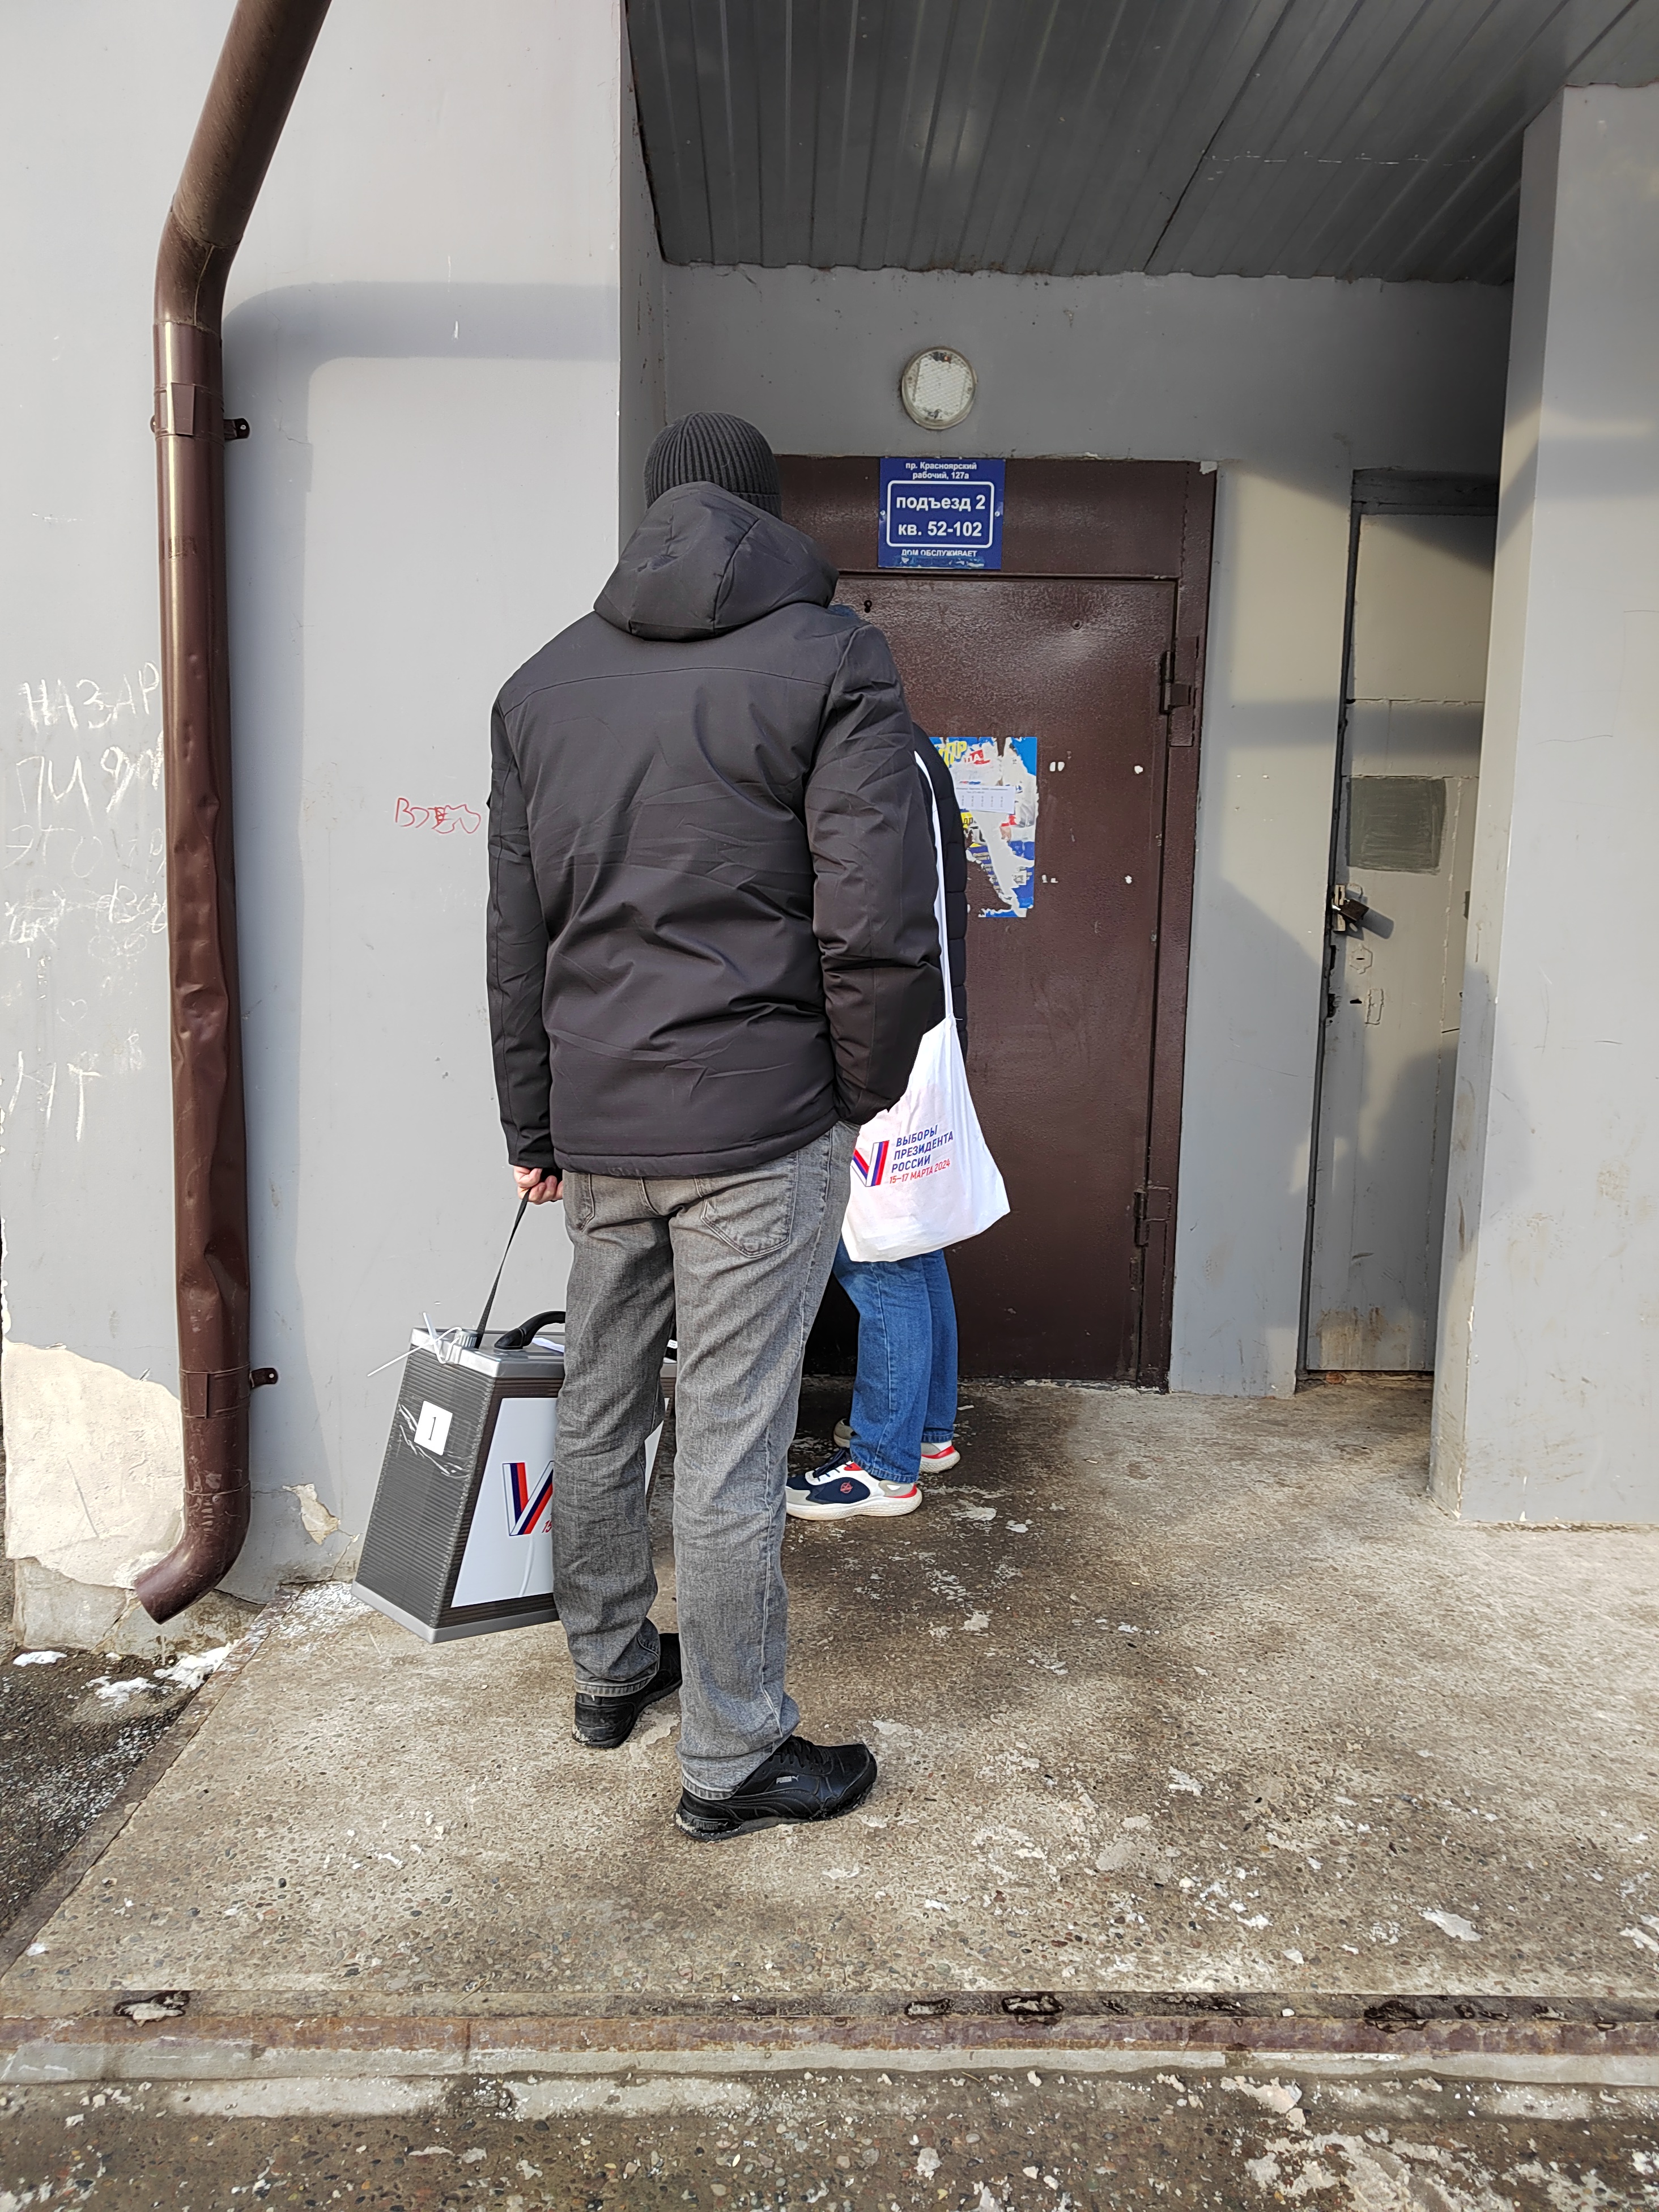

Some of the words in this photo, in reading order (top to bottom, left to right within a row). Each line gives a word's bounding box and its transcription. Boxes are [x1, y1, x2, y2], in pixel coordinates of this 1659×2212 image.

[912, 471, 949, 480] рабочий,
[920, 462, 977, 470] Красноярский
[896, 496, 971, 512] подъезд
[975, 495, 986, 509] 2
[898, 524, 922, 535] кв.
[928, 521, 982, 537] 52-102
[896, 1124, 938, 1147] ВЫБОРЫ
[894, 1131, 954, 1160] ПРЕЗИДЕНТА
[891, 1154, 931, 1173] РОССИИ
[910, 1166, 933, 1180] МАРТА
[934, 1159, 951, 1172] 2024
[428, 1416, 436, 1441] 1
